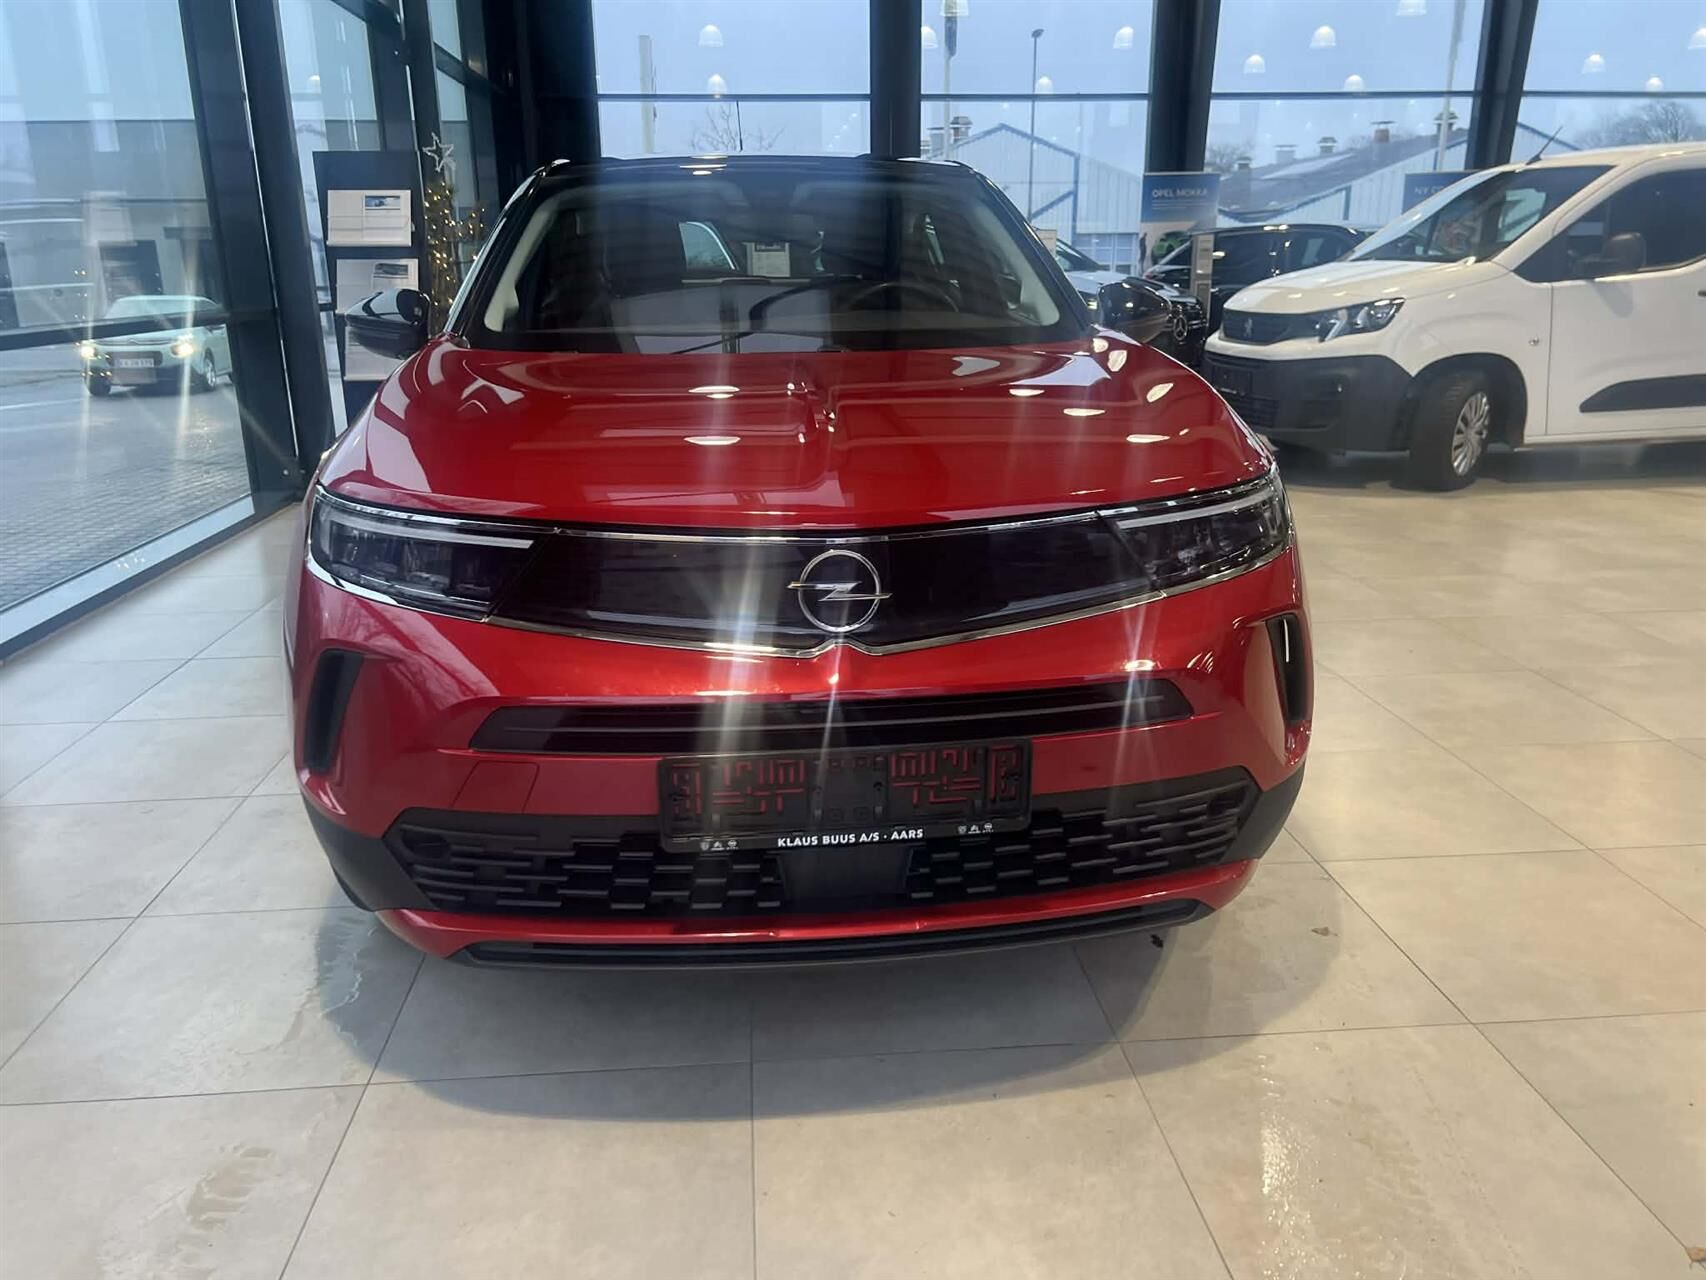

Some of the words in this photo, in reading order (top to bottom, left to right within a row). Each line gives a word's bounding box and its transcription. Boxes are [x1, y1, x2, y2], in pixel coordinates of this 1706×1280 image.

[1152, 189, 1173, 198] OPEL
[777, 836, 818, 847] KLAUS
[822, 834, 855, 845] BUUS
[859, 832, 880, 842] A/S
[890, 829, 924, 840] AARS
